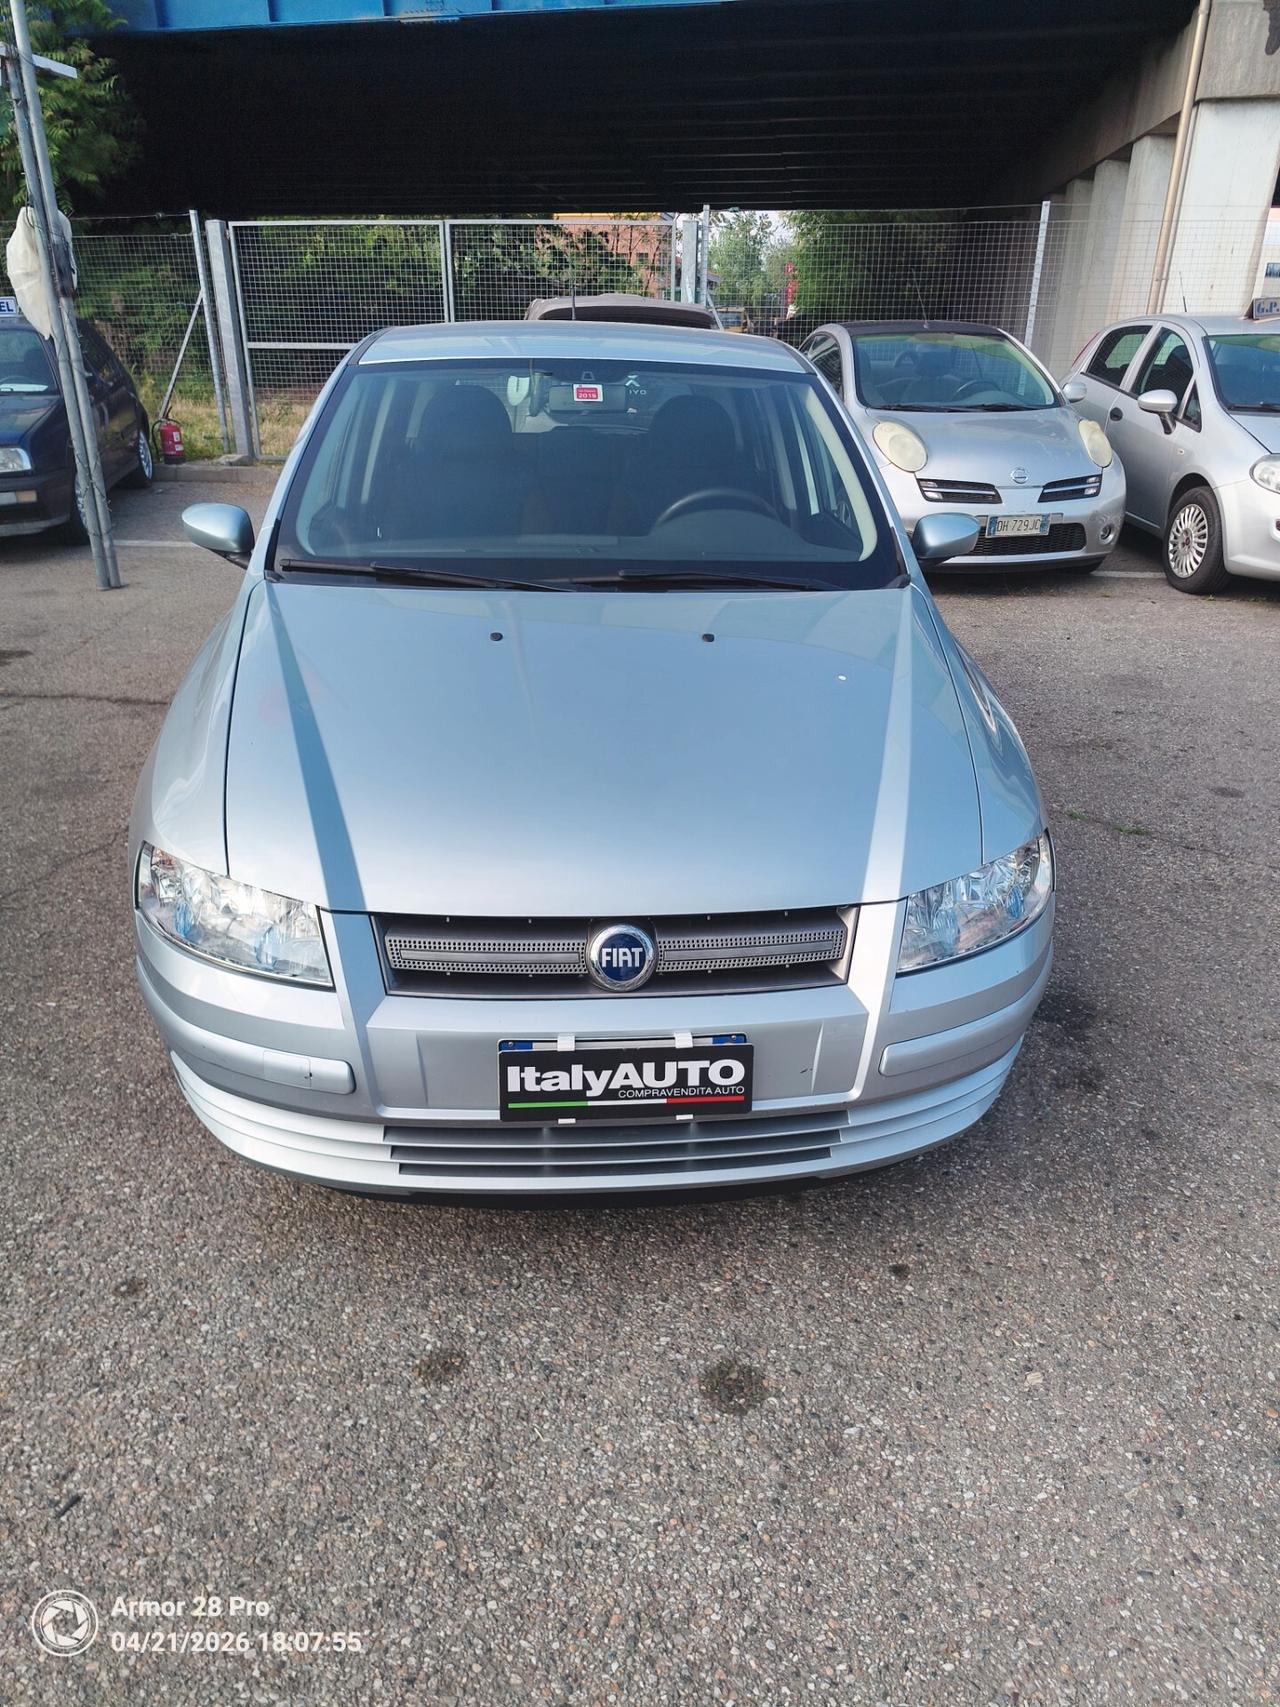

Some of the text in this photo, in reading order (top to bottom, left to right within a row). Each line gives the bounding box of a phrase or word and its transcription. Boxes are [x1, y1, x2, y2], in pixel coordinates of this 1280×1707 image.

[601, 947, 643, 968] FIAT
[507, 1058, 746, 1098] ItalyAUTO
[618, 1085, 745, 1099] COMPRAVENDITA AUTO
